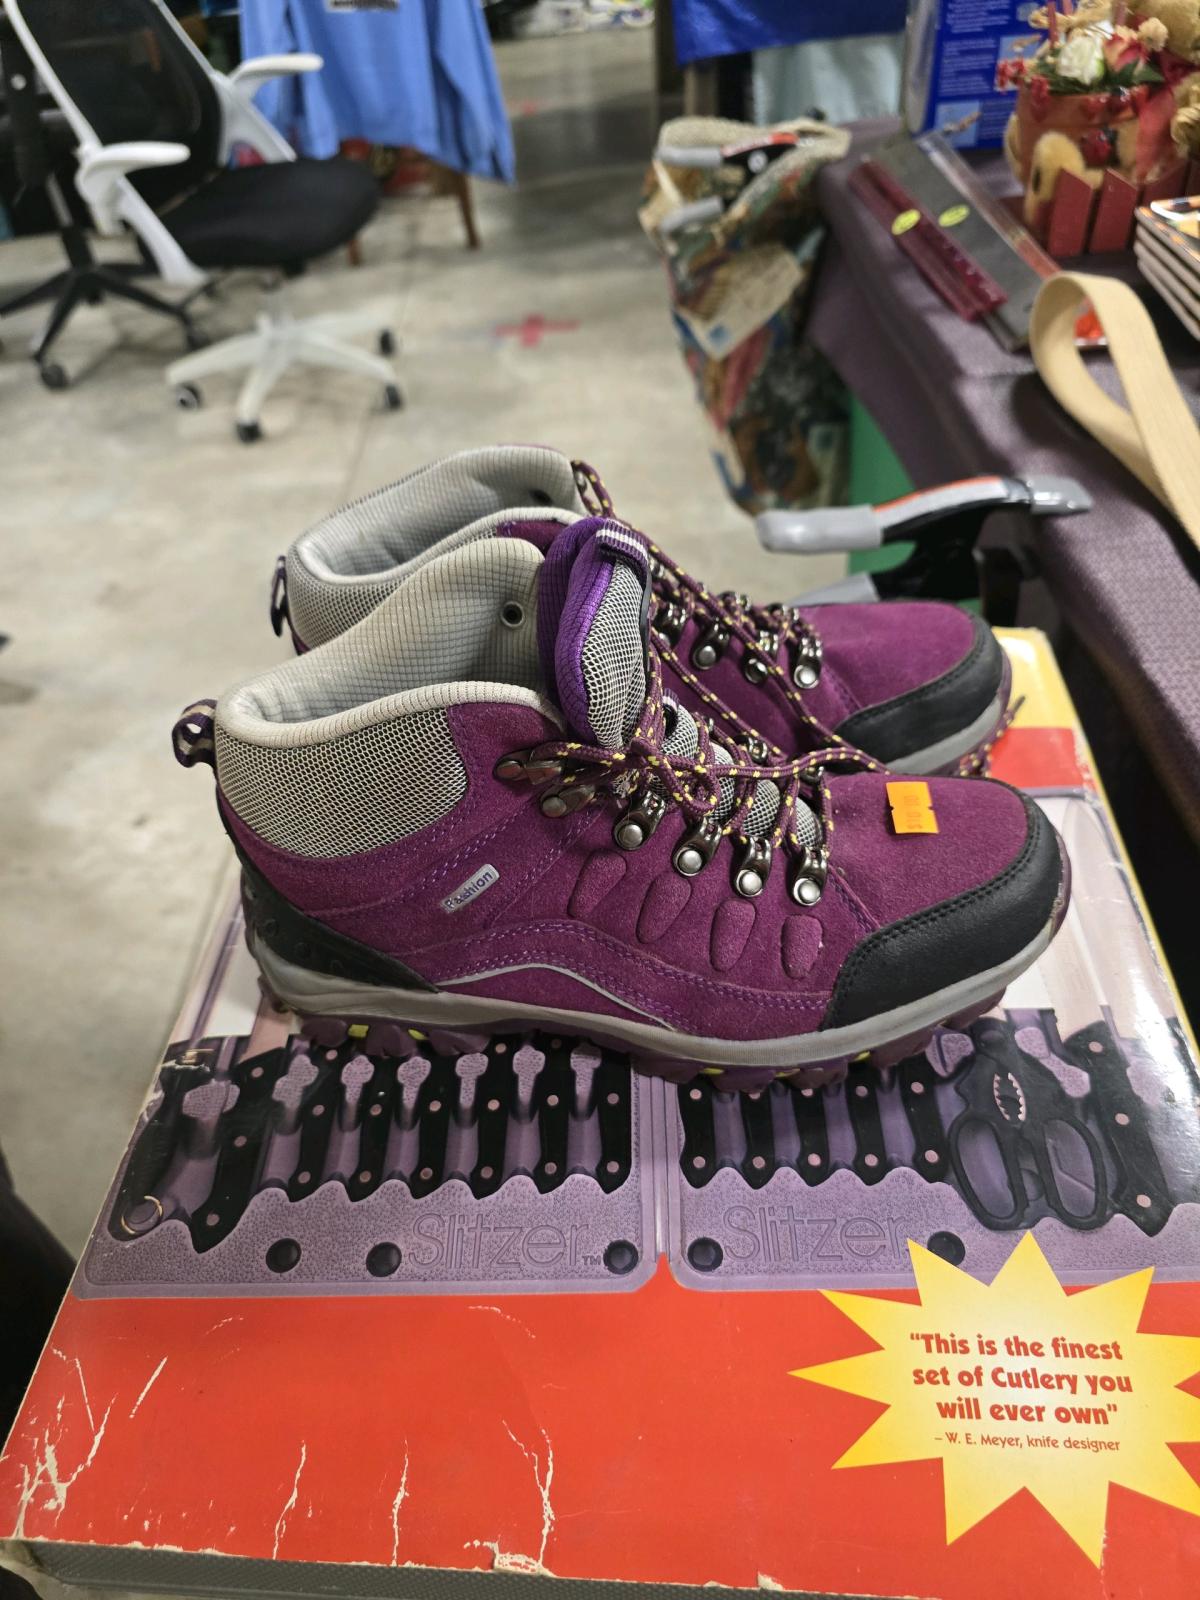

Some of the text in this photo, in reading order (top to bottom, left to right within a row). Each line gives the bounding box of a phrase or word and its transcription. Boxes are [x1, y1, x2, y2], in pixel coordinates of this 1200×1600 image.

[444, 871, 493, 909] Fashion
[408, 1213, 589, 1269] Slitzer
[723, 1205, 906, 1262] Slitzer
[977, 1334, 997, 1355] is
[1004, 1336, 1045, 1357] the
[1051, 1337, 1122, 1360] finest
[913, 1366, 1133, 1395] set of Cutlery you
[936, 1396, 981, 1419] will
[990, 1404, 1045, 1422] ever
[945, 1432, 960, 1443] W.
[965, 1433, 976, 1444] E.
[981, 1435, 1022, 1448] Meyer,
[1027, 1436, 1059, 1448] knife
[1064, 1437, 1119, 1452] designer
